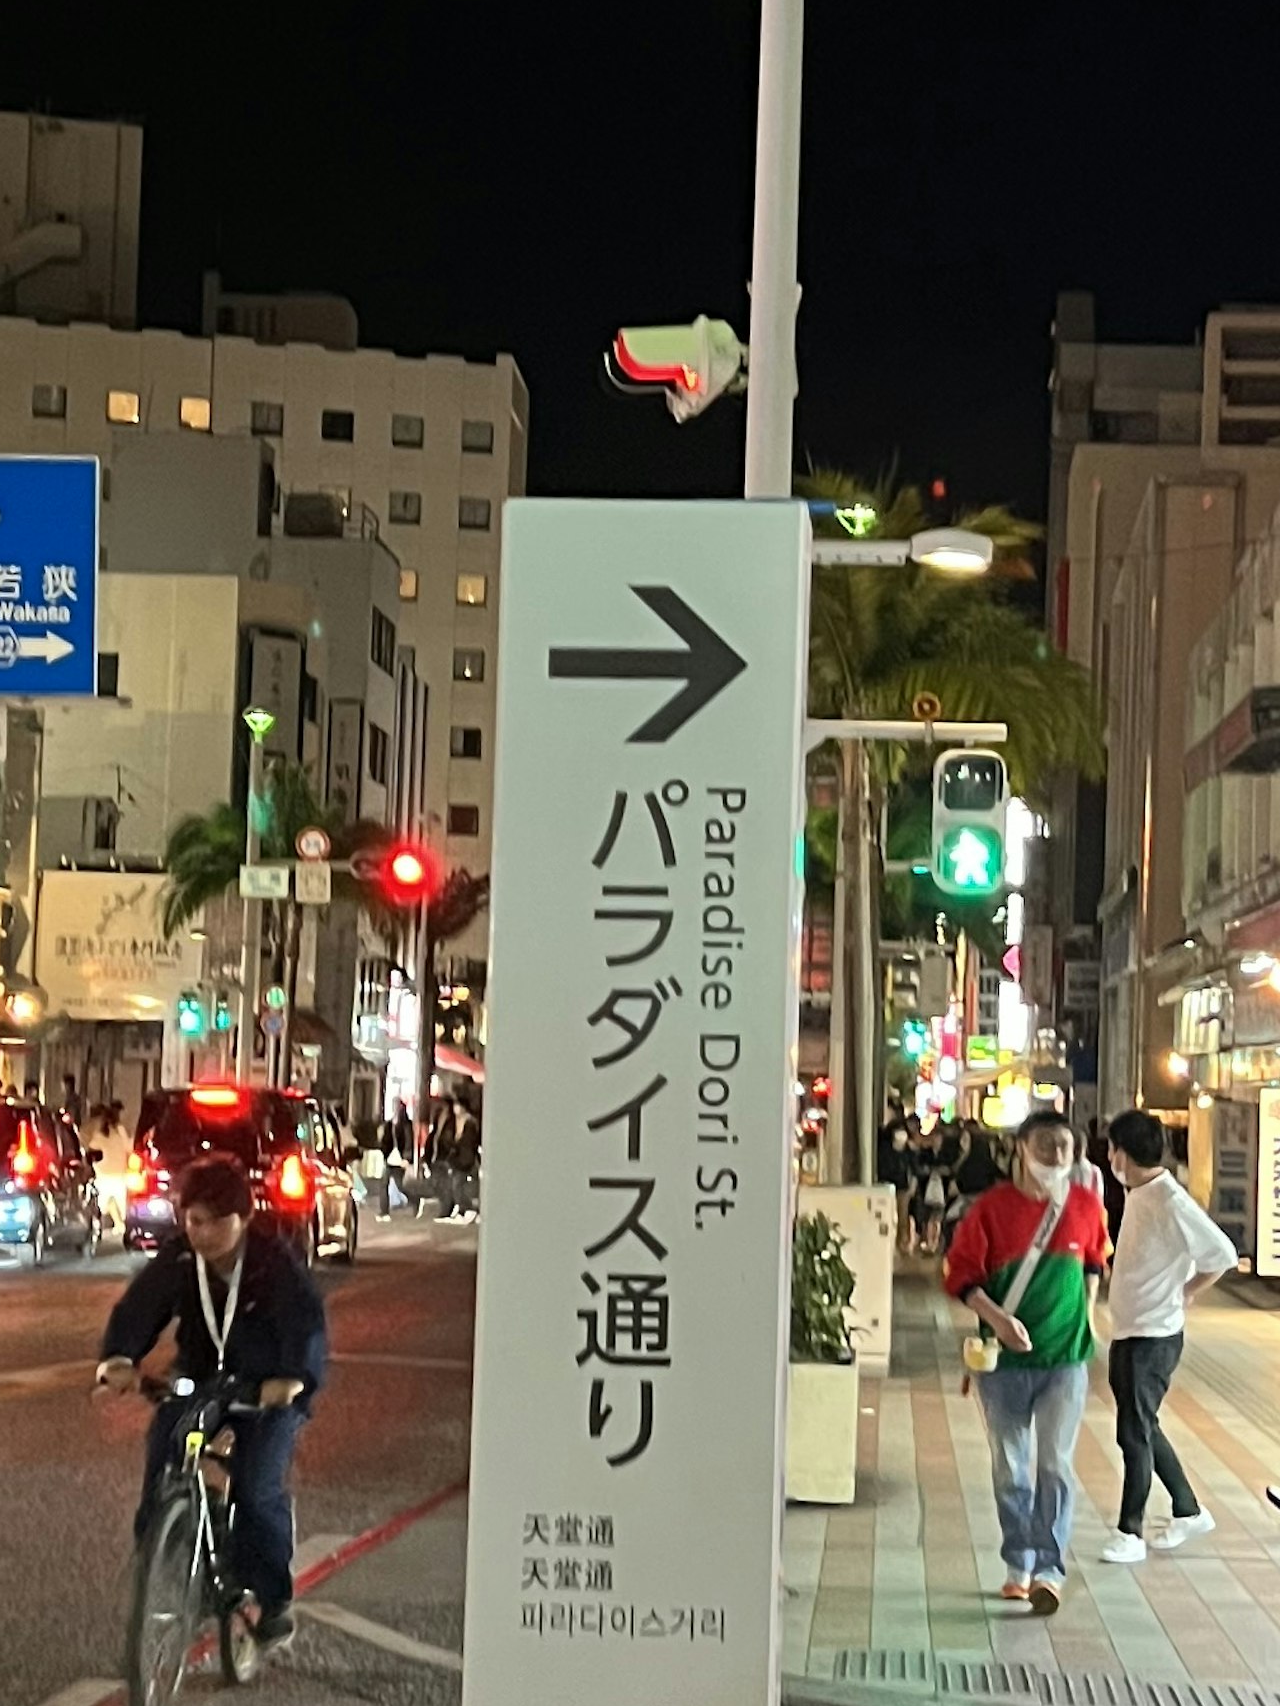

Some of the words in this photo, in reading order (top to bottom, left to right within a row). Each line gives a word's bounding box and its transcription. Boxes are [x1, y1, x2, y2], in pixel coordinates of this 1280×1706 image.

[700, 787, 748, 1010] Paradise
[575, 779, 689, 1468] パラダイス通り
[696, 1034, 742, 1145] Dori
[695, 1165, 739, 1231] St.
[521, 1511, 615, 1549] 天堂通
